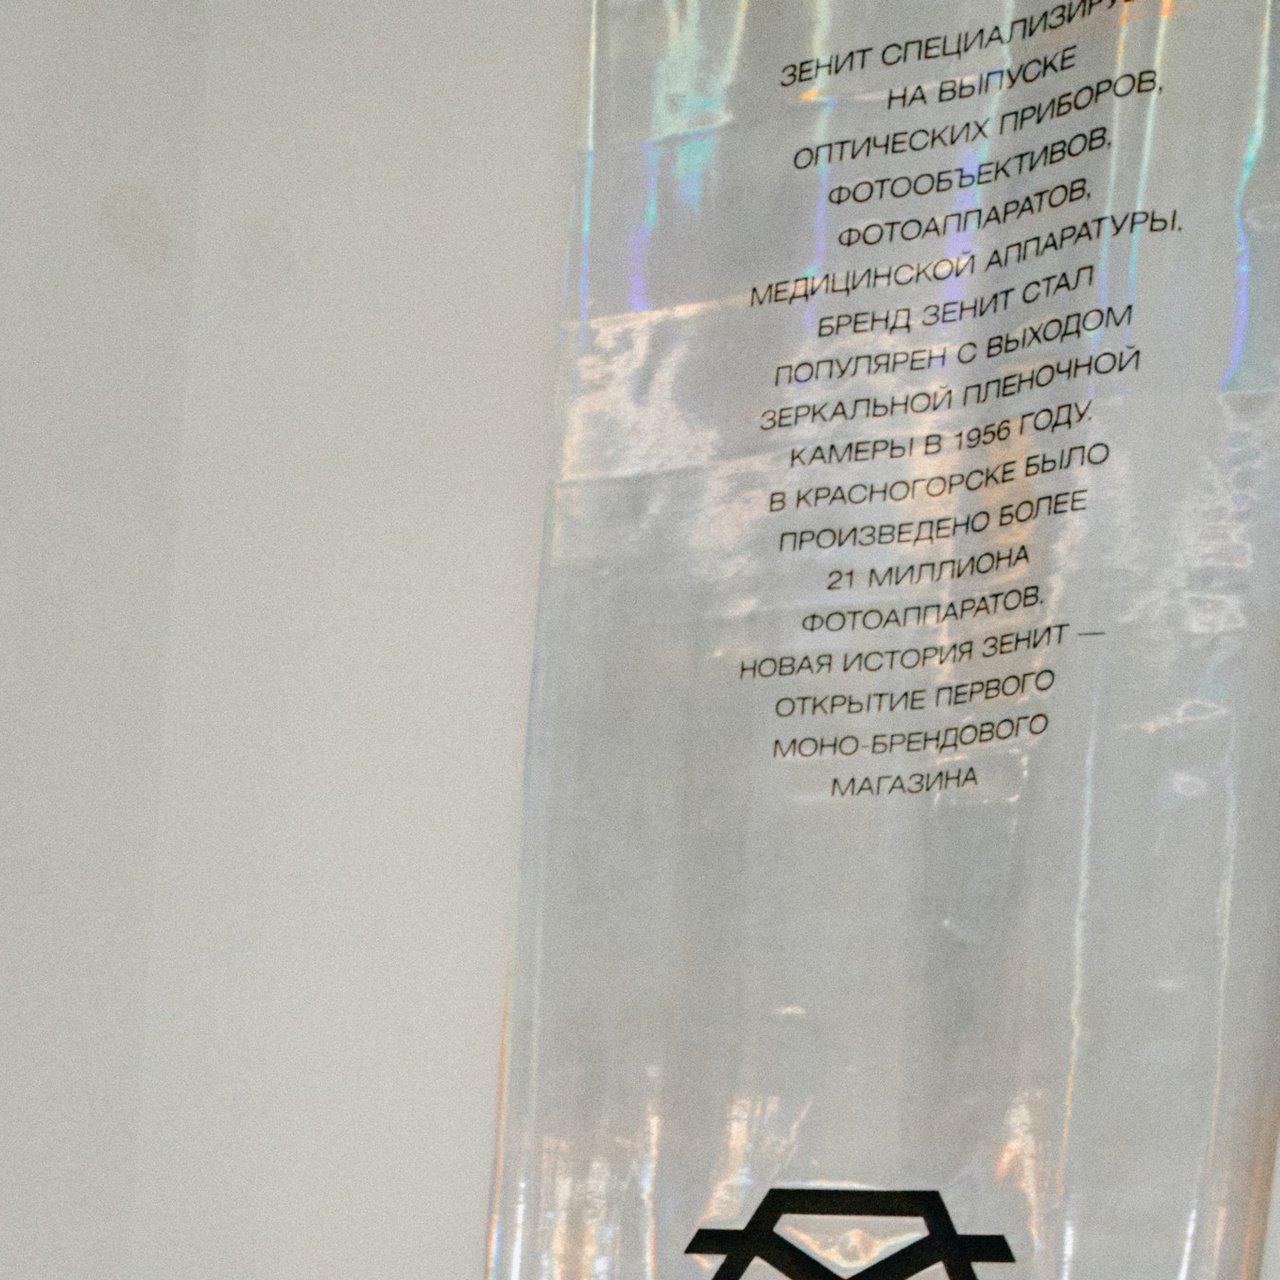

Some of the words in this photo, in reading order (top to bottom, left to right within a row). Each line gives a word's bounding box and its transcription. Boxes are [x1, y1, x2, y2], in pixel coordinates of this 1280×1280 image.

[780, 47, 873, 87] ЗЕНИТ
[881, 0, 1134, 66] СПЕЦИАЛИЗИР
[888, 85, 927, 110] НА
[938, 45, 1077, 103] ВЫПУСКЕ
[793, 118, 989, 169] ОПТИЧЕСКИХ
[999, 70, 1163, 135] ПРИБОРОВ,
[828, 127, 1111, 206] ФОТООБЪЕКТИВОВ,
[838, 178, 1090, 247] ФОТОАППАРАТОВ,
[749, 254, 976, 309] МЕДИЦИНСКОЙ
[985, 209, 1182, 272] АППАРАТУРЫ.
[818, 308, 912, 338] БРЕНД
[922, 289, 1015, 326] ЗЕНИТ
[1022, 266, 1094, 303] СТАЛ
[775, 347, 947, 386] ПОПУЛЯРЕН
[957, 342, 977, 363] С
[986, 304, 1133, 357] ВЫХОДОМ
[760, 384, 952, 431] ЗЕРКАЛЬНОЙ
[962, 345, 1141, 407] ПЛЕНОЧНОЙ
[790, 439, 914, 467] КАМЕРЫ
[924, 434, 943, 454] В
[955, 419, 1011, 451] 1956
[1020, 400, 1092, 437] ГОДУ.
[769, 491, 788, 511] В
[795, 462, 1016, 509] КРАСНОГОРСКЕ
[1024, 442, 1110, 478] БЫЛО
[778, 511, 990, 552] ПРОИЗВЕДЕНО
[999, 489, 1088, 526] БОЛЕЕ
[827, 568, 856, 591] 21
[868, 545, 1030, 589] МИЛЛИОНА
[801, 585, 1044, 633] ФОТОАППАРАТОВ.
[739, 654, 833, 680] НОВАЯ
[841, 640, 974, 674] ИСТОРИЯ
[981, 623, 1070, 660] ЗЕНИТ
[775, 688, 926, 718] ОТКРЫТИЕ
[934, 669, 1055, 708] ПЕРВОГО
[772, 713, 1049, 760] МОНО-БРЕНДОВОГО
[831, 767, 978, 799] МАГАЗИНА
